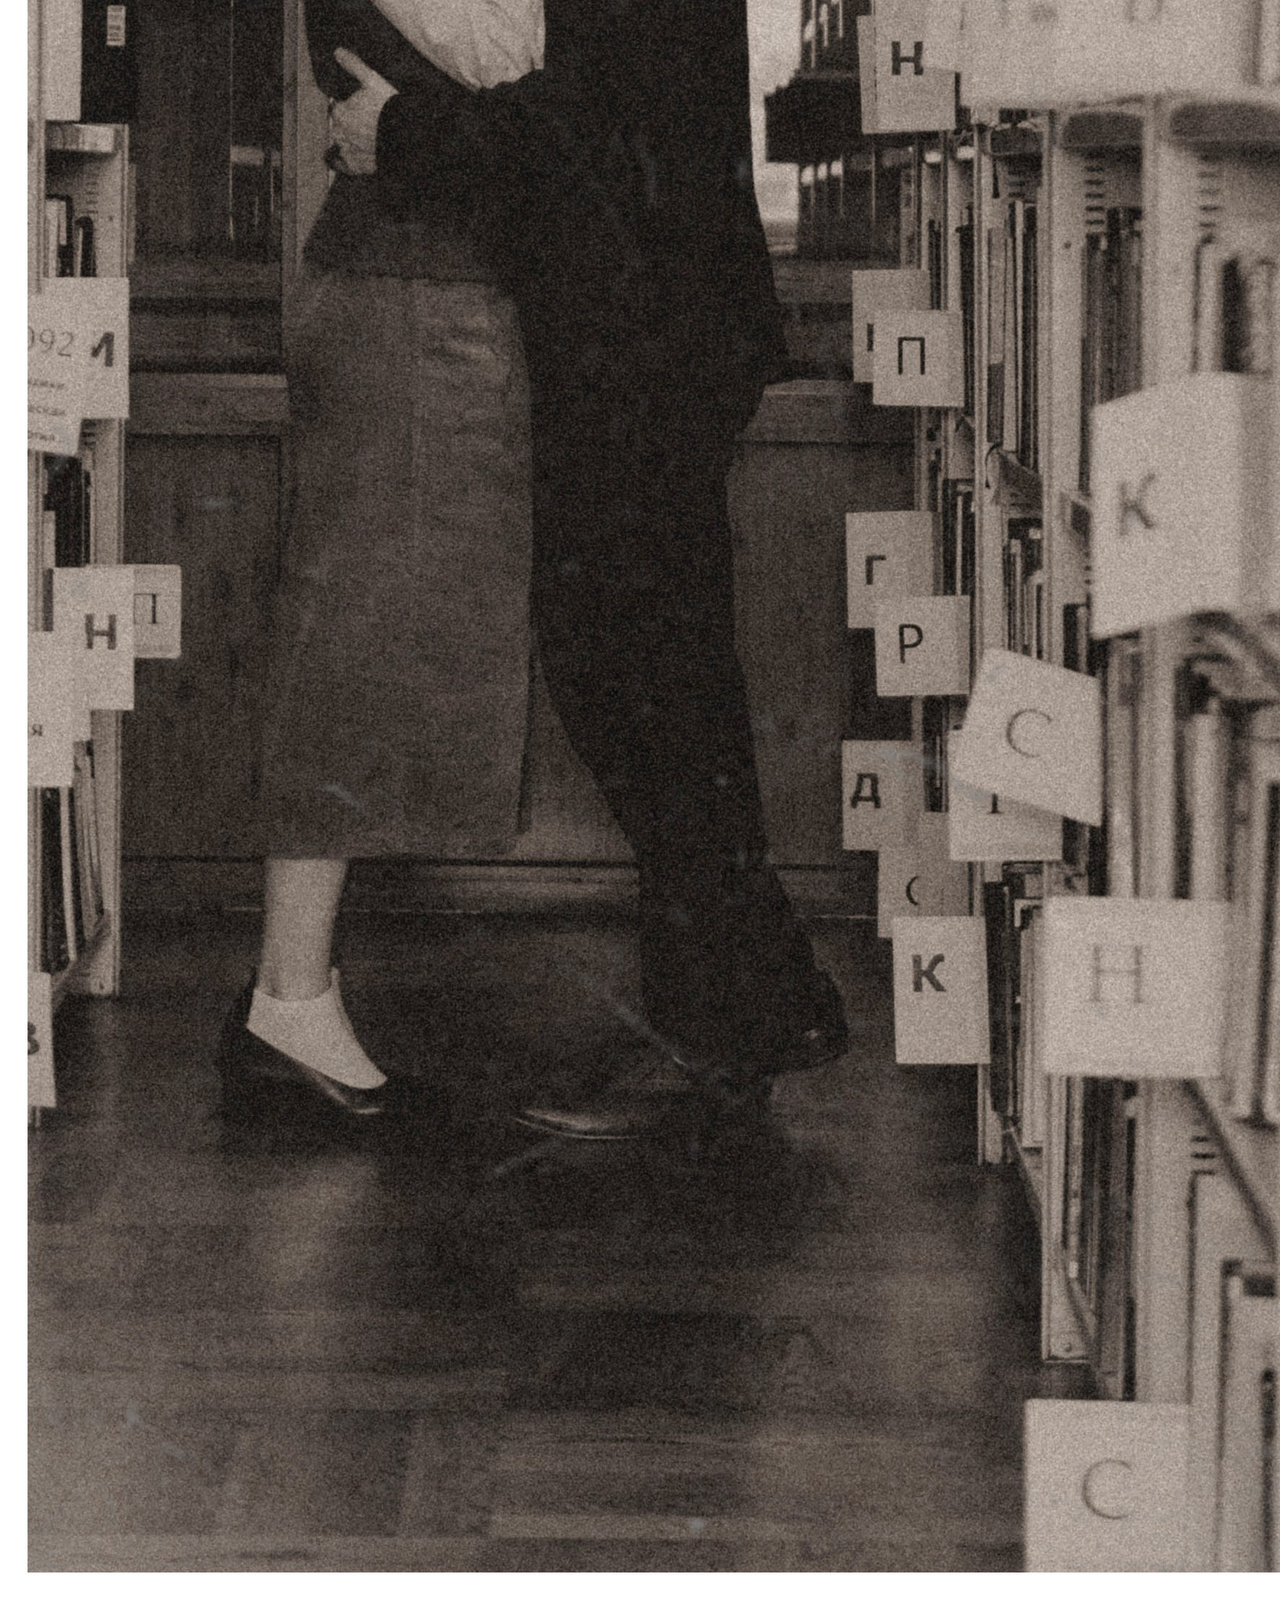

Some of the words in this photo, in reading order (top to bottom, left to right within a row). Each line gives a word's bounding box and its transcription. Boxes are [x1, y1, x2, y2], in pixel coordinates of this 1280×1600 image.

[891, 40, 923, 76] Н
[898, 336, 926, 376] П
[1118, 472, 1157, 536] К
[865, 555, 887, 586] Г
[85, 614, 117, 650] Н
[899, 623, 924, 664] Р
[1005, 708, 1053, 758] С
[850, 773, 882, 810] Д
[912, 954, 947, 993] К
[1091, 943, 1144, 1005] Н
[1081, 1457, 1133, 1521] С
